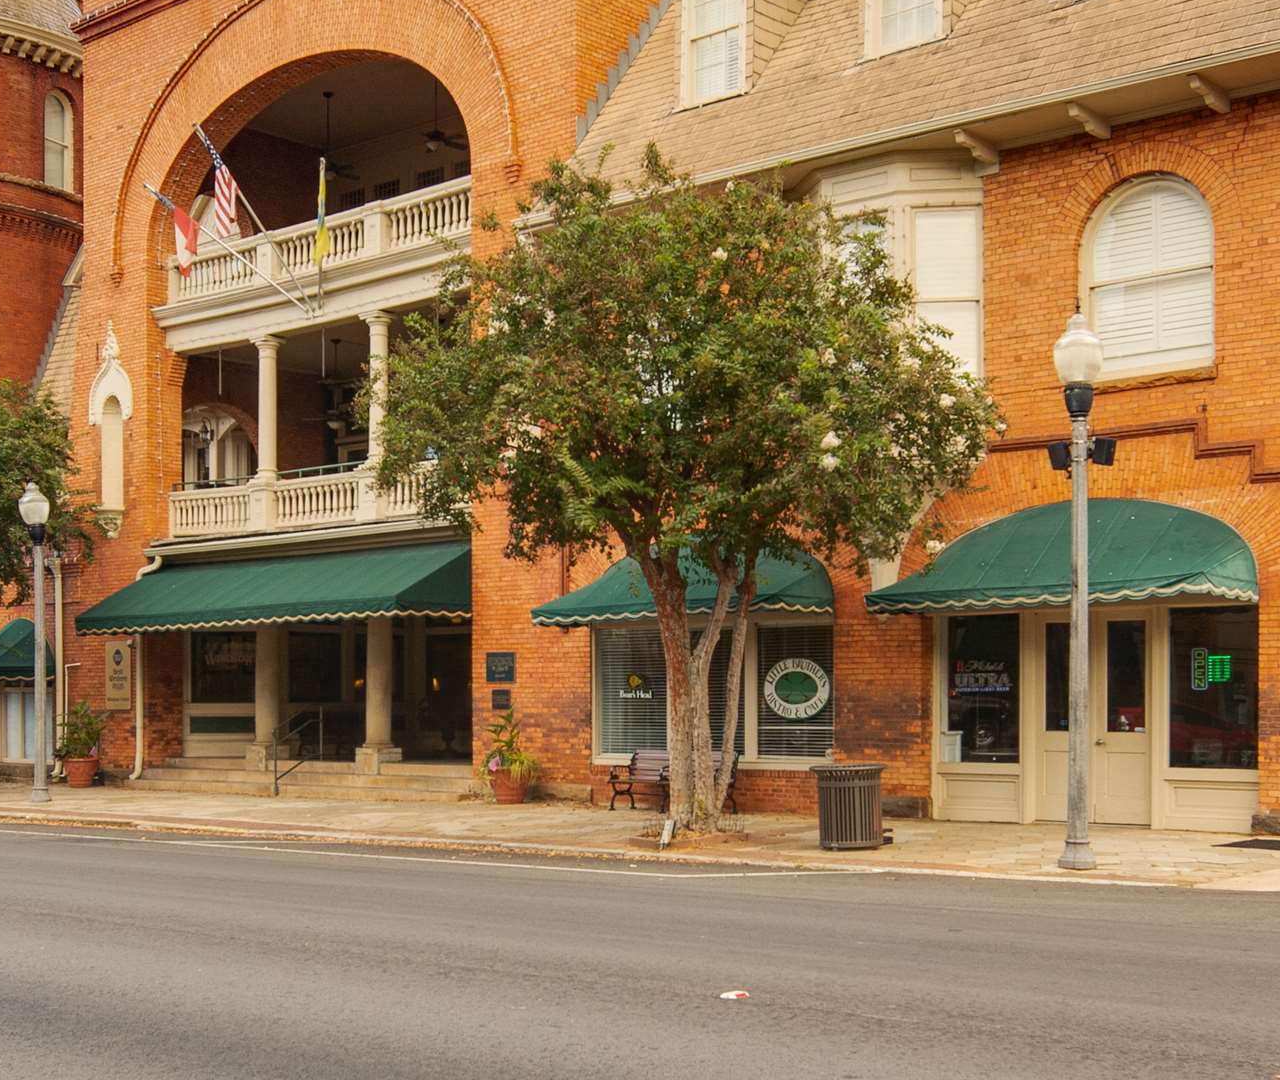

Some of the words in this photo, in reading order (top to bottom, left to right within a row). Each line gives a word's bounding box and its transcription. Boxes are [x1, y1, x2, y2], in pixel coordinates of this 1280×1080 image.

[766, 661, 788, 685] LITTLE
[954, 673, 1011, 687] ULTRA
[1194, 650, 1205, 688] OPEN
[767, 693, 792, 716] BISTRO
